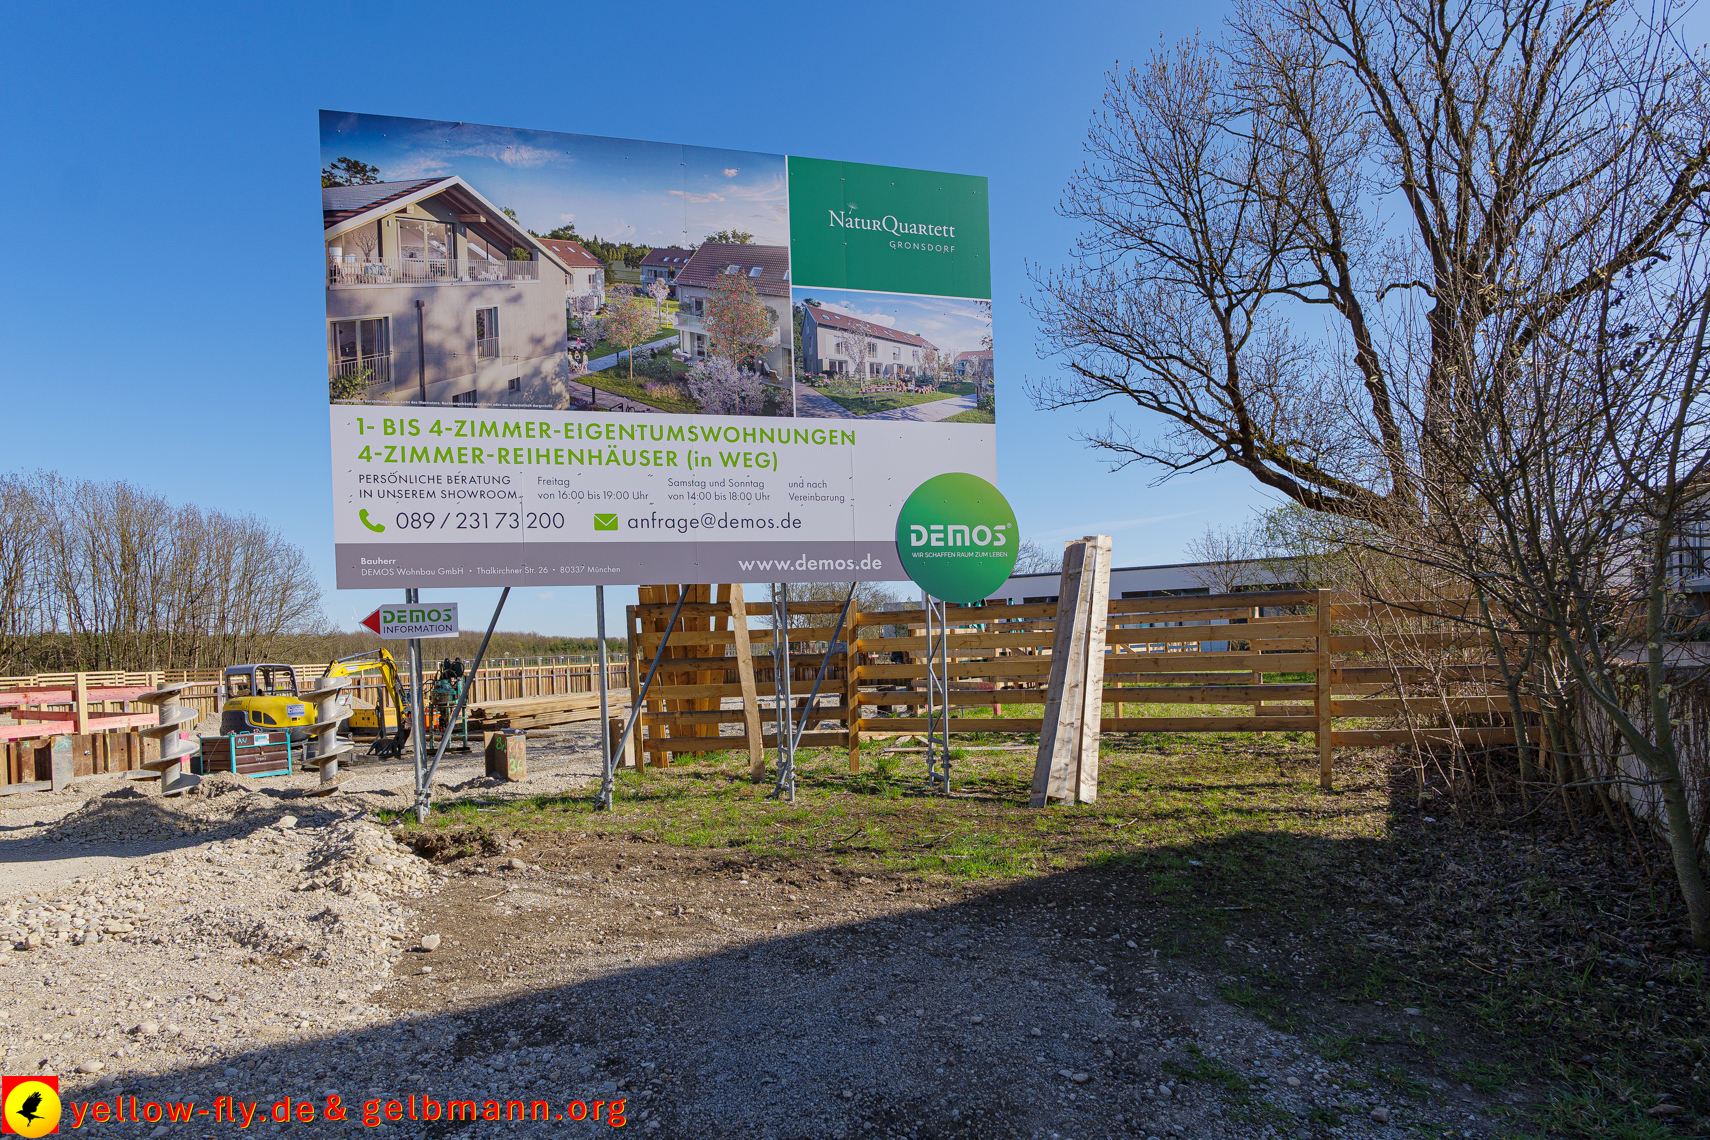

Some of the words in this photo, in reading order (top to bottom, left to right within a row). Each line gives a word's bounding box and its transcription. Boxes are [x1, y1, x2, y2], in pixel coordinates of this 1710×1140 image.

[889, 240, 955, 253] GRONSDORF
[356, 418, 374, 436] 1-
[383, 418, 420, 437] BIS
[428, 419, 856, 446] 4-ZIMMER-EIGENTUMSWOHNUNGEN
[358, 445, 678, 466] 4-ZIMMER-REIHENHÄUSER
[687, 450, 712, 471] (in
[719, 451, 778, 472] WEG)
[359, 472, 442, 484] PERSÖNLICHE
[447, 475, 511, 485] BERATUNG
[537, 476, 570, 488] Freitag
[668, 478, 706, 489] Samstag
[709, 478, 725, 488] und
[728, 479, 765, 490] Sonntag
[788, 479, 804, 488] und
[806, 479, 827, 489] nach
[359, 489, 373, 499] IN
[377, 489, 436, 499] UNSEREM
[441, 490, 517, 499] SHOWROOM
[558, 490, 584, 500] 16:00
[588, 490, 600, 500] bis
[603, 491, 629, 500] 19:00
[632, 491, 648, 500] Uhr
[686, 492, 711, 500] 14:00
[714, 491, 726, 500] bis
[728, 492, 753, 501] 18:00
[755, 492, 770, 501] Uhr
[788, 493, 845, 503] Vereinbarung
[396, 512, 436, 529] 089
[526, 512, 565, 529] 200
[628, 511, 802, 533] anfrage@demos.de
[738, 553, 882, 572] www.demos.de
[396, 568, 435, 576] Wohnbau
[437, 567, 464, 575] GmbH
[477, 567, 522, 575] Thalkirchner
[538, 566, 548, 574] 26
[560, 565, 585, 574] 80337
[383, 624, 453, 634] INFORMATION
